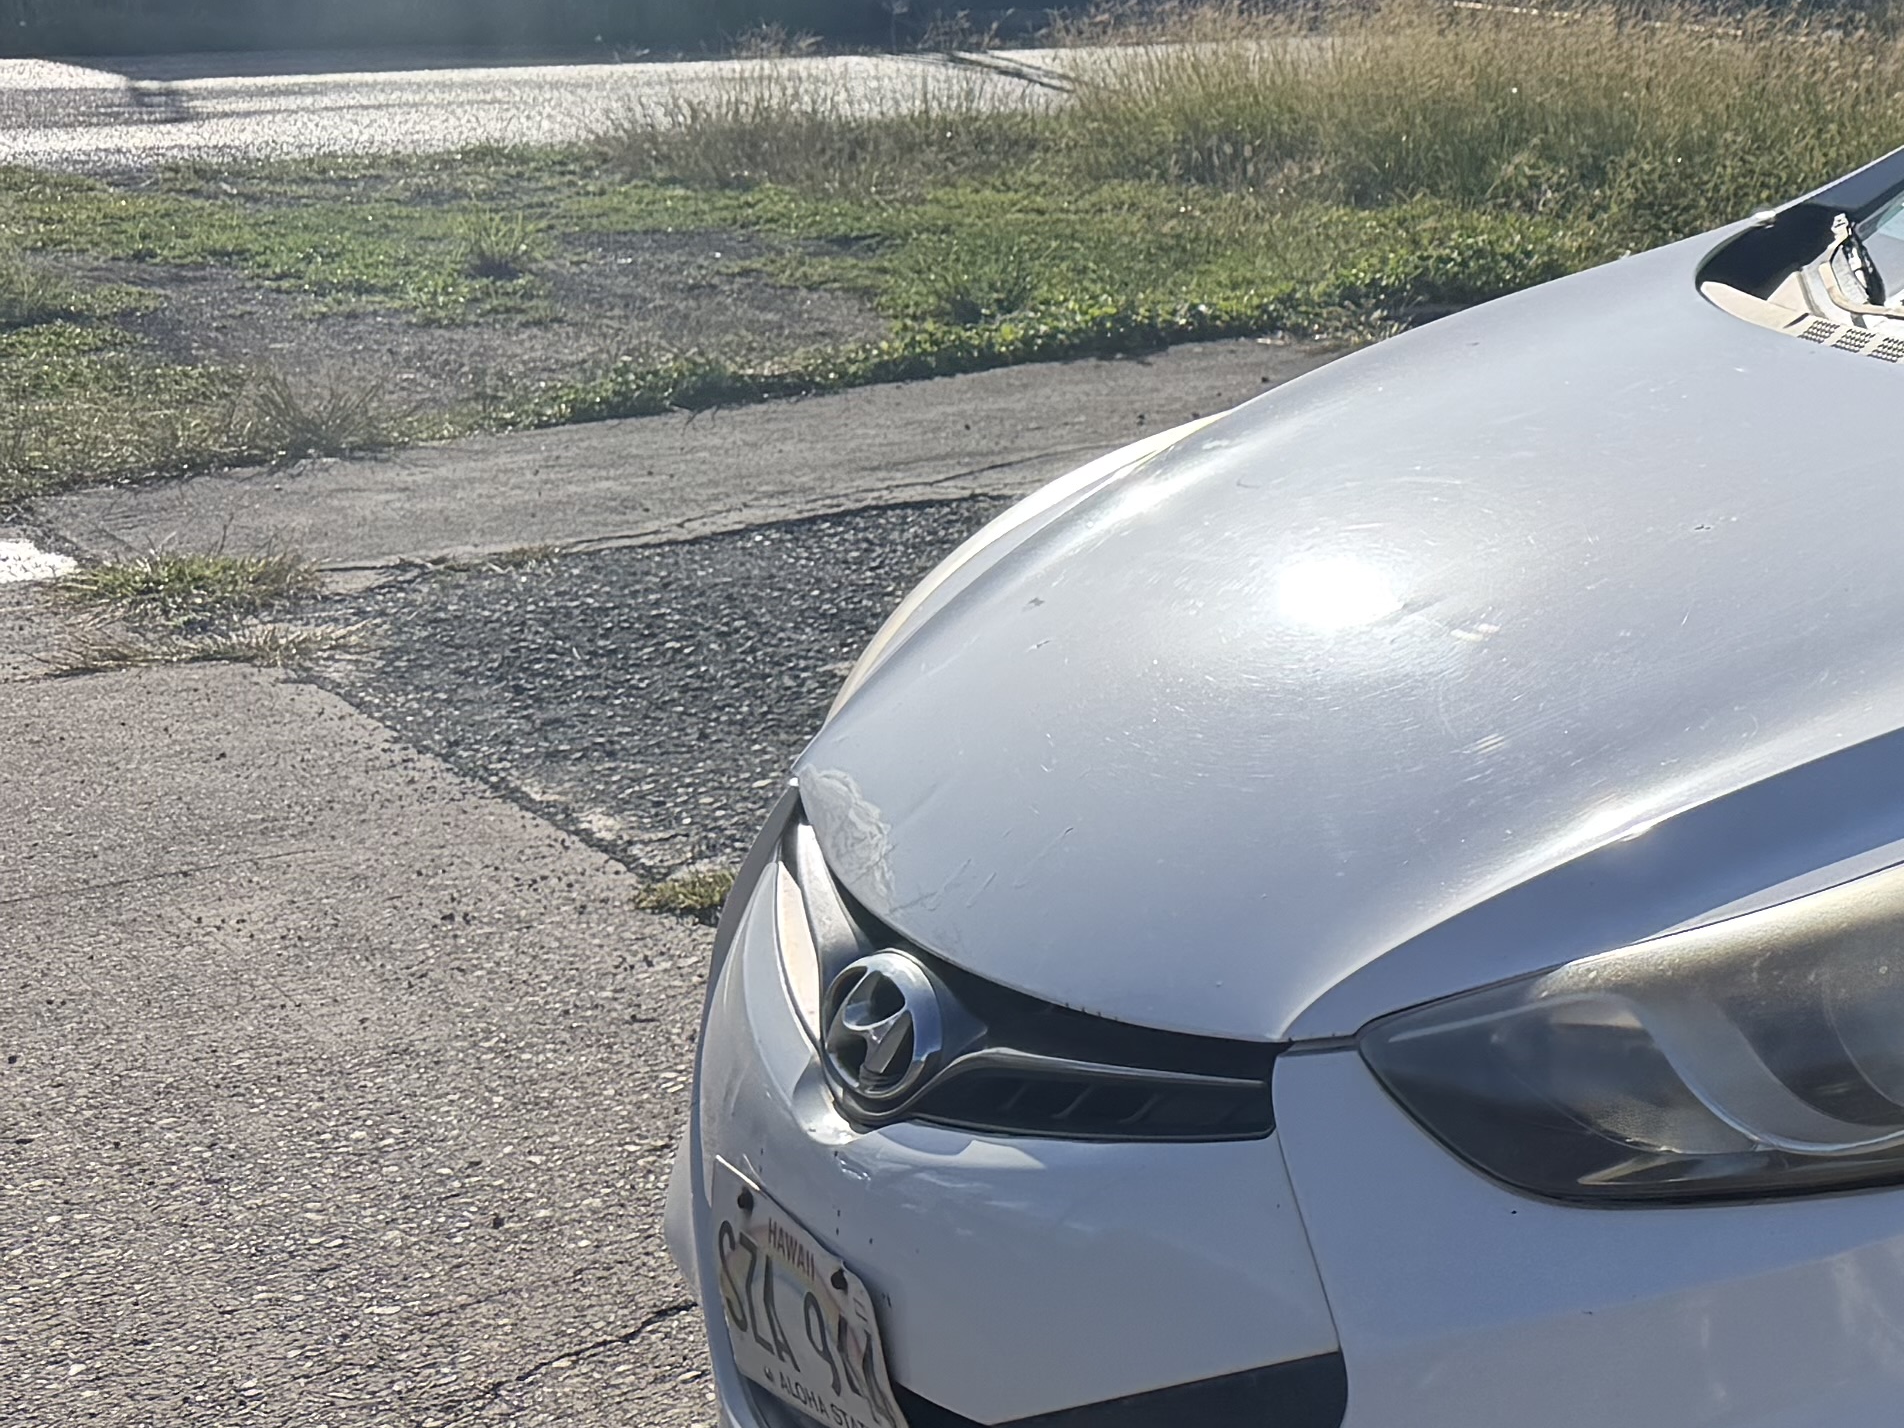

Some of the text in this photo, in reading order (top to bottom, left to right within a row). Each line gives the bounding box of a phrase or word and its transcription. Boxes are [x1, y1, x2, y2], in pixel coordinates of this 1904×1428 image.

[767, 1217, 816, 1281] HAWAII
[718, 1220, 801, 1373] SZA
[780, 1375, 830, 1416] ALOHA
